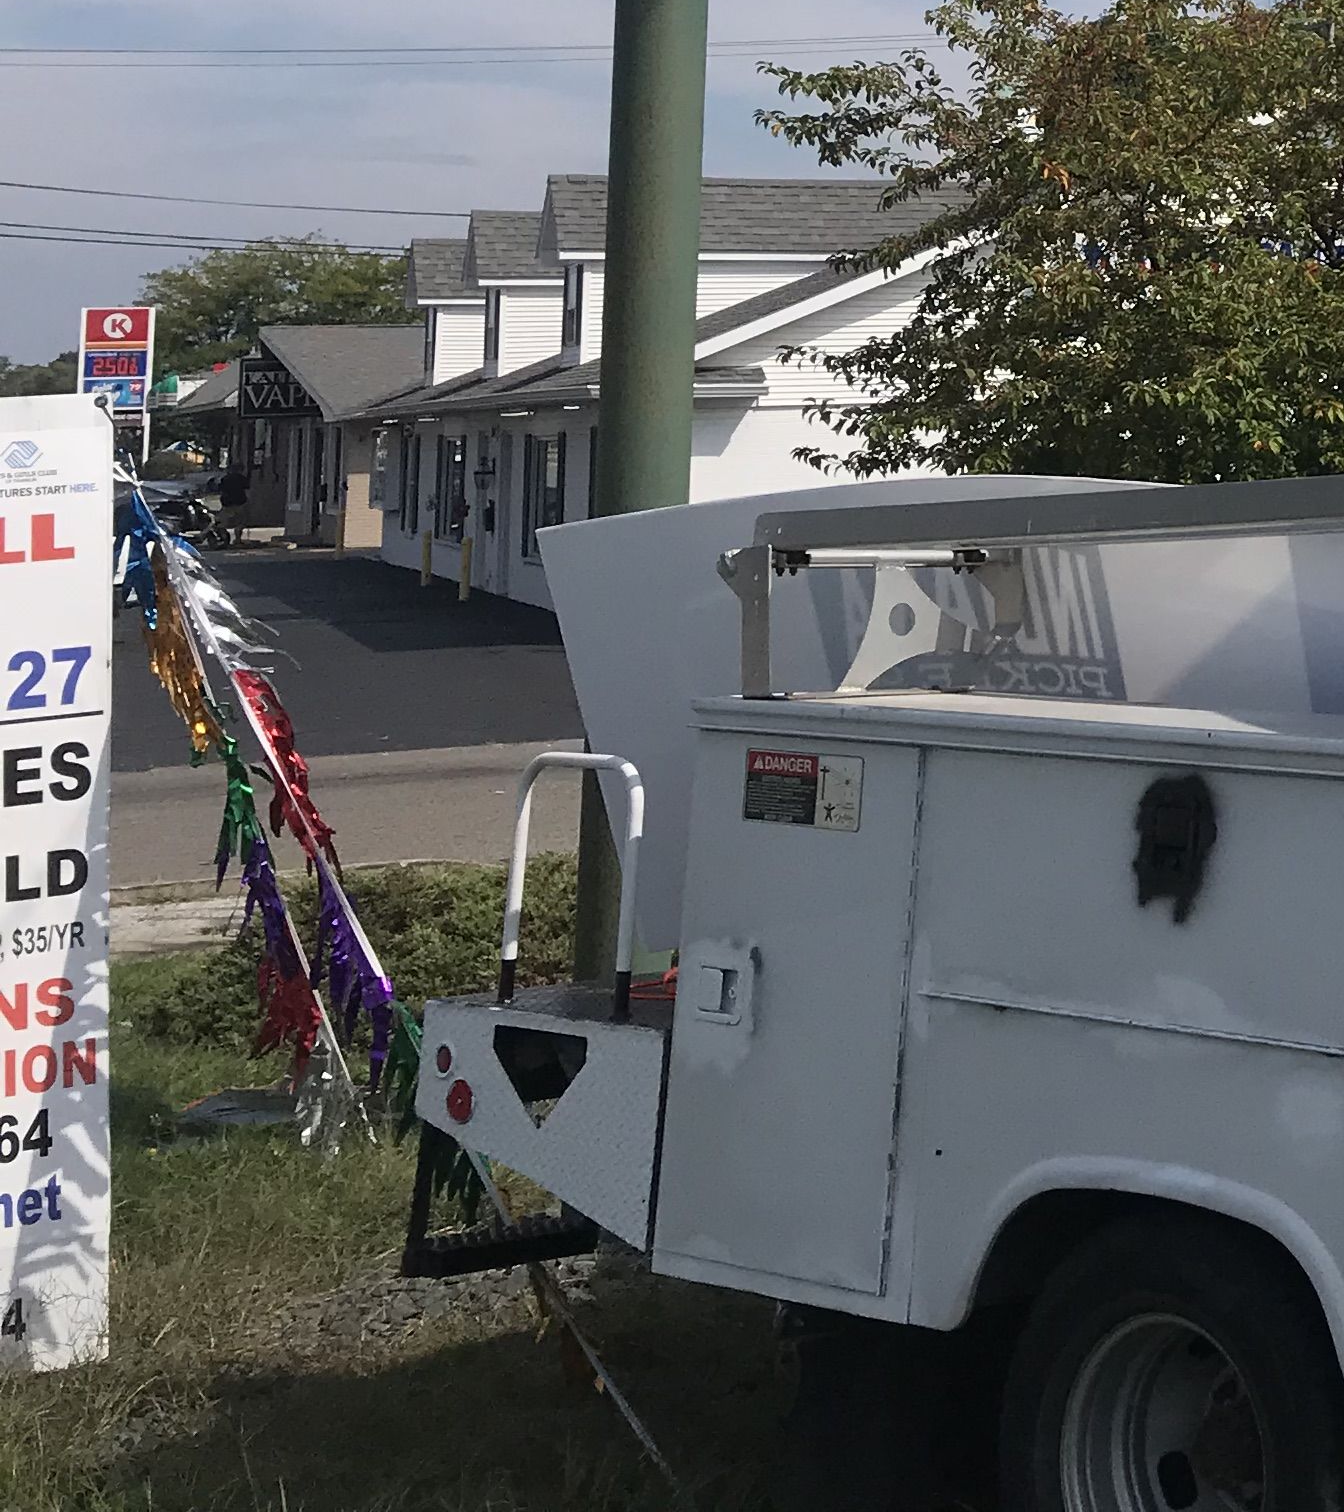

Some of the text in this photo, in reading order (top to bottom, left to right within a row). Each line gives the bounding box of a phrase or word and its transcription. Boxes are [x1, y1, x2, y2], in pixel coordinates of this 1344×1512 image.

[35, 484, 68, 496] START
[6, 645, 92, 712] 27
[3, 741, 92, 808] ES
[764, 755, 812, 773] DANGER
[5, 847, 88, 903] LD
[12, 921, 86, 959] $35/YR
[4, 1037, 97, 1098] ION
[0, 1108, 53, 1164] 64
